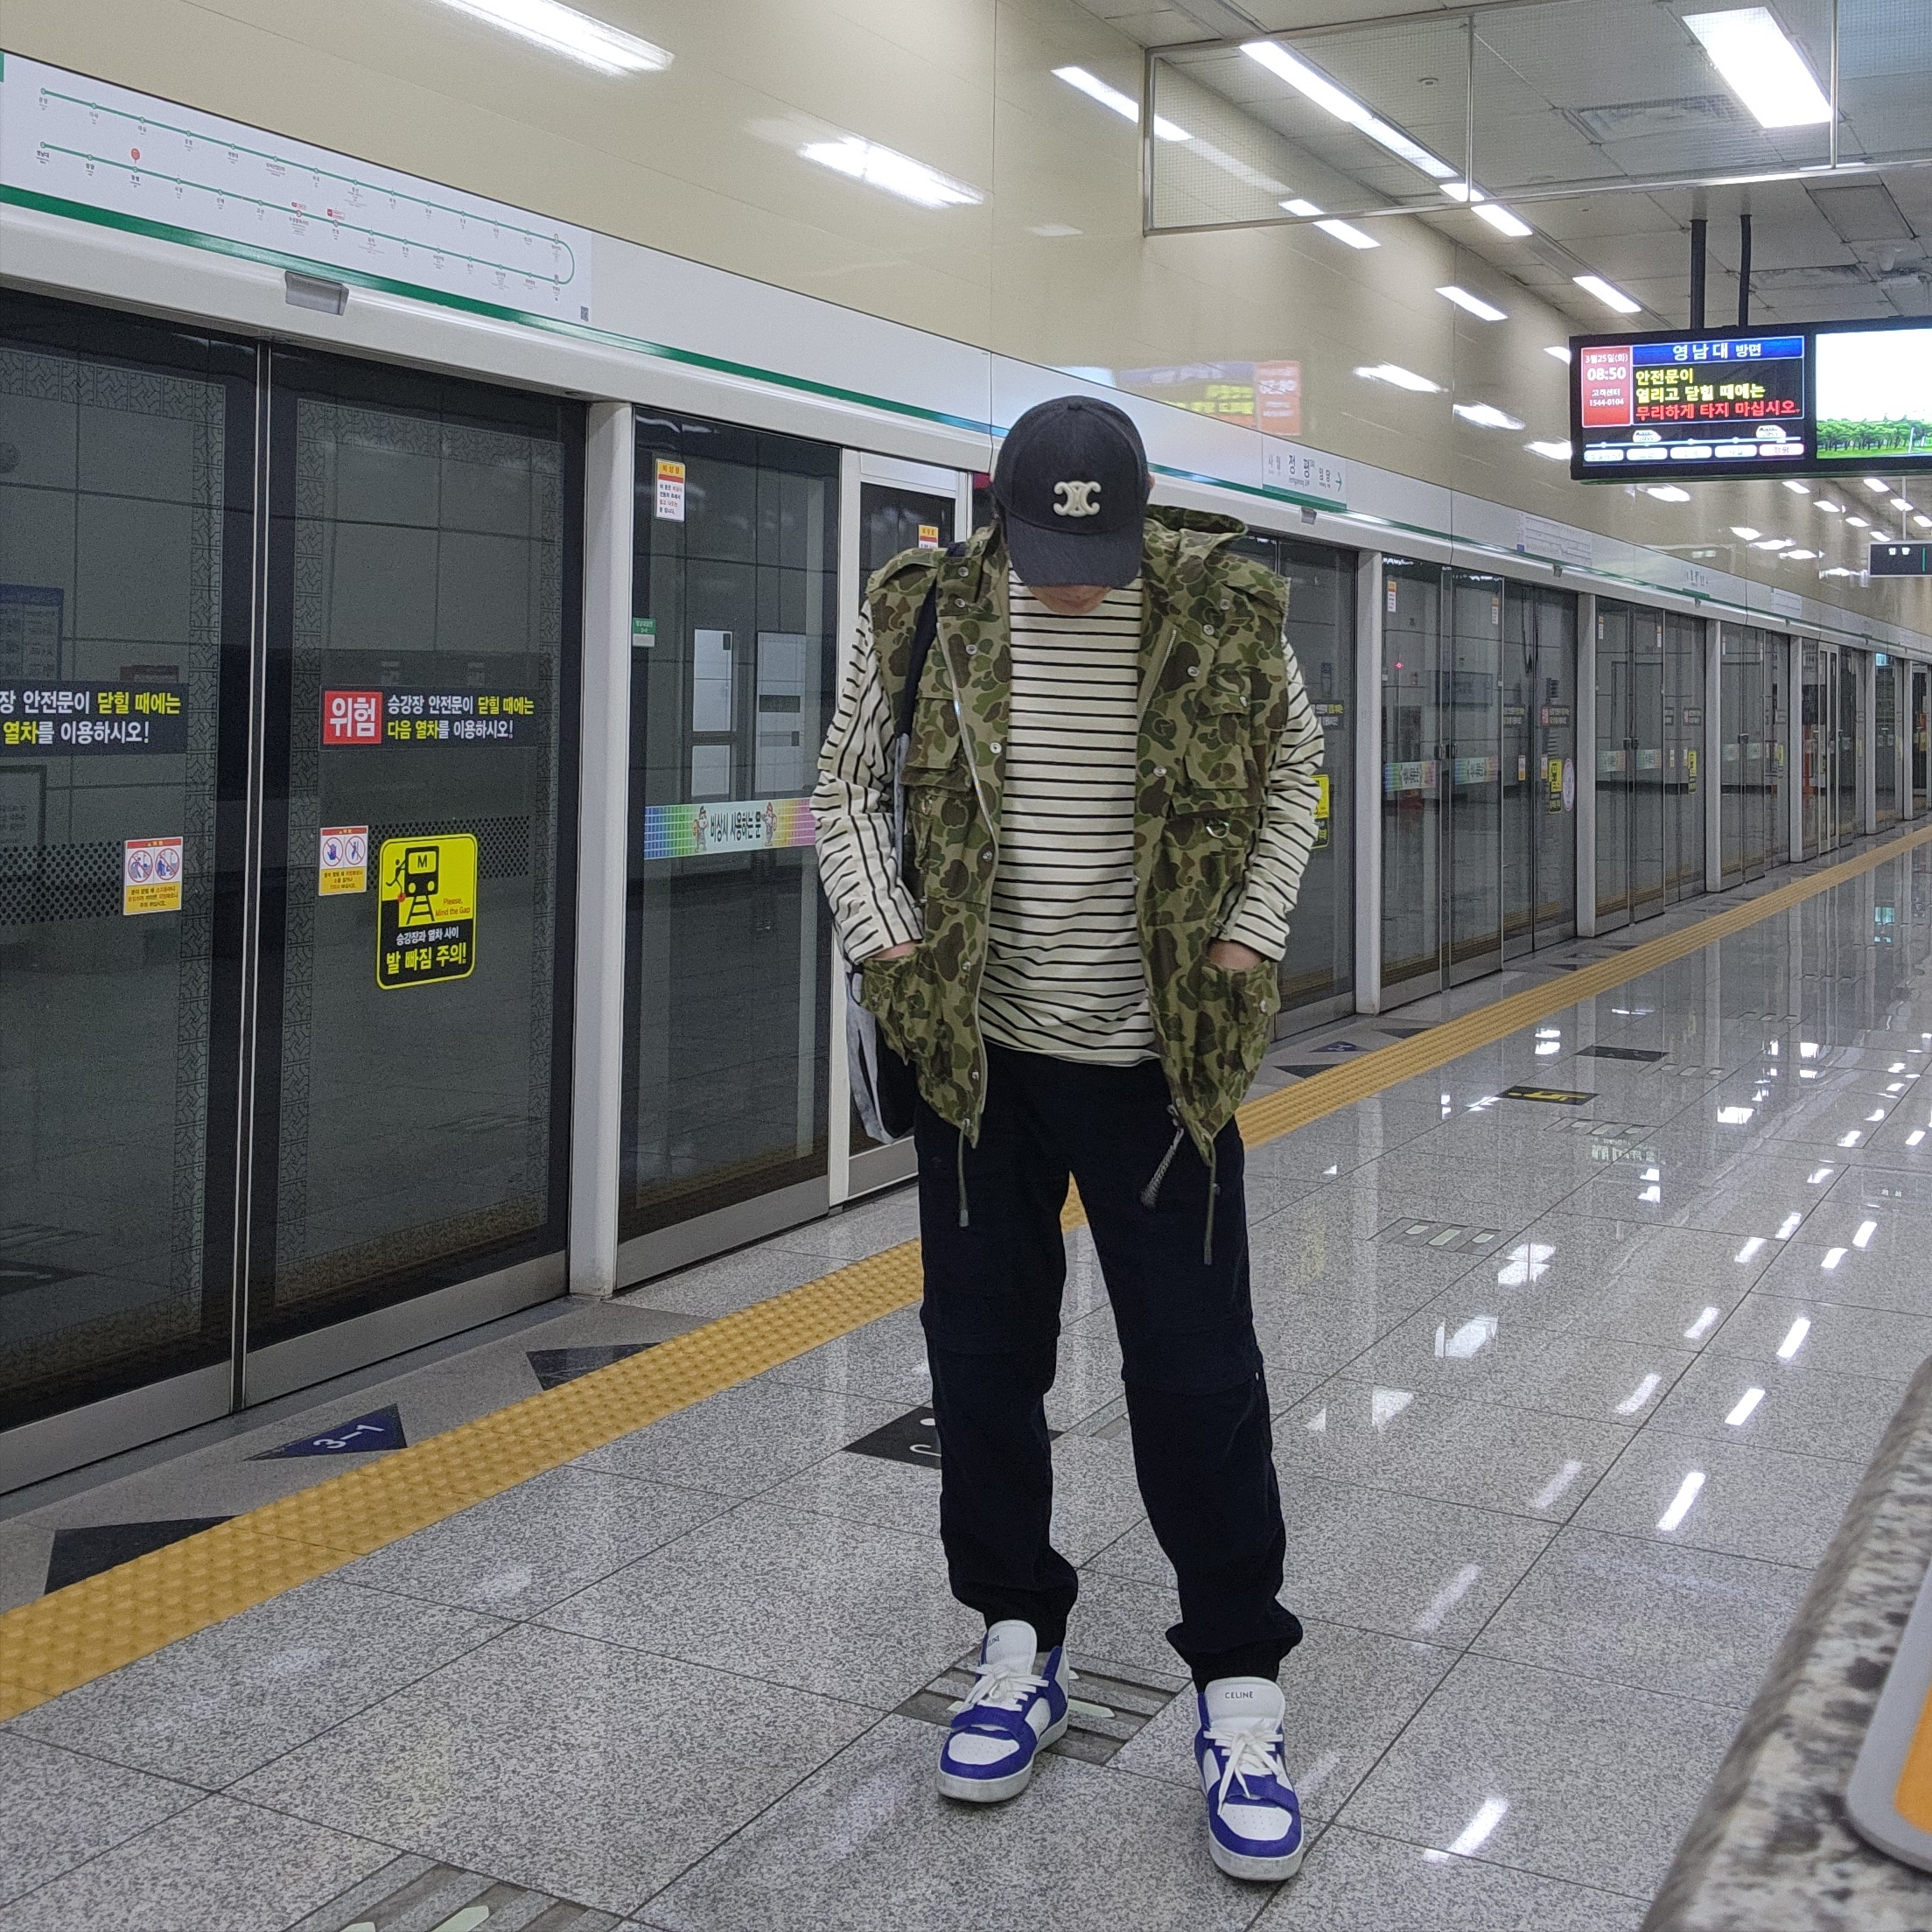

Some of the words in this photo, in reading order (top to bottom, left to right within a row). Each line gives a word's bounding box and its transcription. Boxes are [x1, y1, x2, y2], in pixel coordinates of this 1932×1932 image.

[1735, 343, 1762, 358] 방면
[1586, 366, 1627, 382] 08:50
[1635, 368, 1693, 386] 안전문이
[1589, 397, 1625, 407] 1544-0104
[1592, 388, 1620, 396] 고객센터
[1635, 386, 1680, 404] 열리고
[1684, 384, 1714, 402] 닫힐
[1719, 382, 1766, 400] 때에는
[1635, 402, 1695, 421] 무리하게
[1699, 402, 1730, 419] 타지
[23, 690, 90, 715] 안전문이
[97, 691, 130, 715] 닫힐
[135, 691, 181, 715] 때에는
[388, 694, 425, 715] 승강장
[428, 695, 473, 715] 안전문이
[478, 696, 500, 715] 닫힐
[503, 696, 535, 715] 때에는
[329, 696, 376, 738] 위험
[3, 720, 54, 745] 열차를
[60, 720, 150, 745] 이용하시오!
[388, 719, 412, 739] 다음
[416, 719, 451, 740] 열차를
[453, 719, 514, 739] 이용하시오!
[710, 812, 729, 843] 비상시
[730, 810, 754, 842] 사용하는
[755, 810, 761, 839] 문
[416, 854, 428, 868] M
[459, 906, 471, 914] Gap
[396, 929, 427, 946] 승강장과
[428, 928, 443, 942] 열차
[444, 925, 459, 939] 사이
[387, 950, 402, 975] 발
[404, 946, 432, 971] 빠짐
[436, 942, 467, 968] 주의!
[312, 1424, 385, 1449] 3-1
[1224, 1690, 1254, 1699] CELINE
